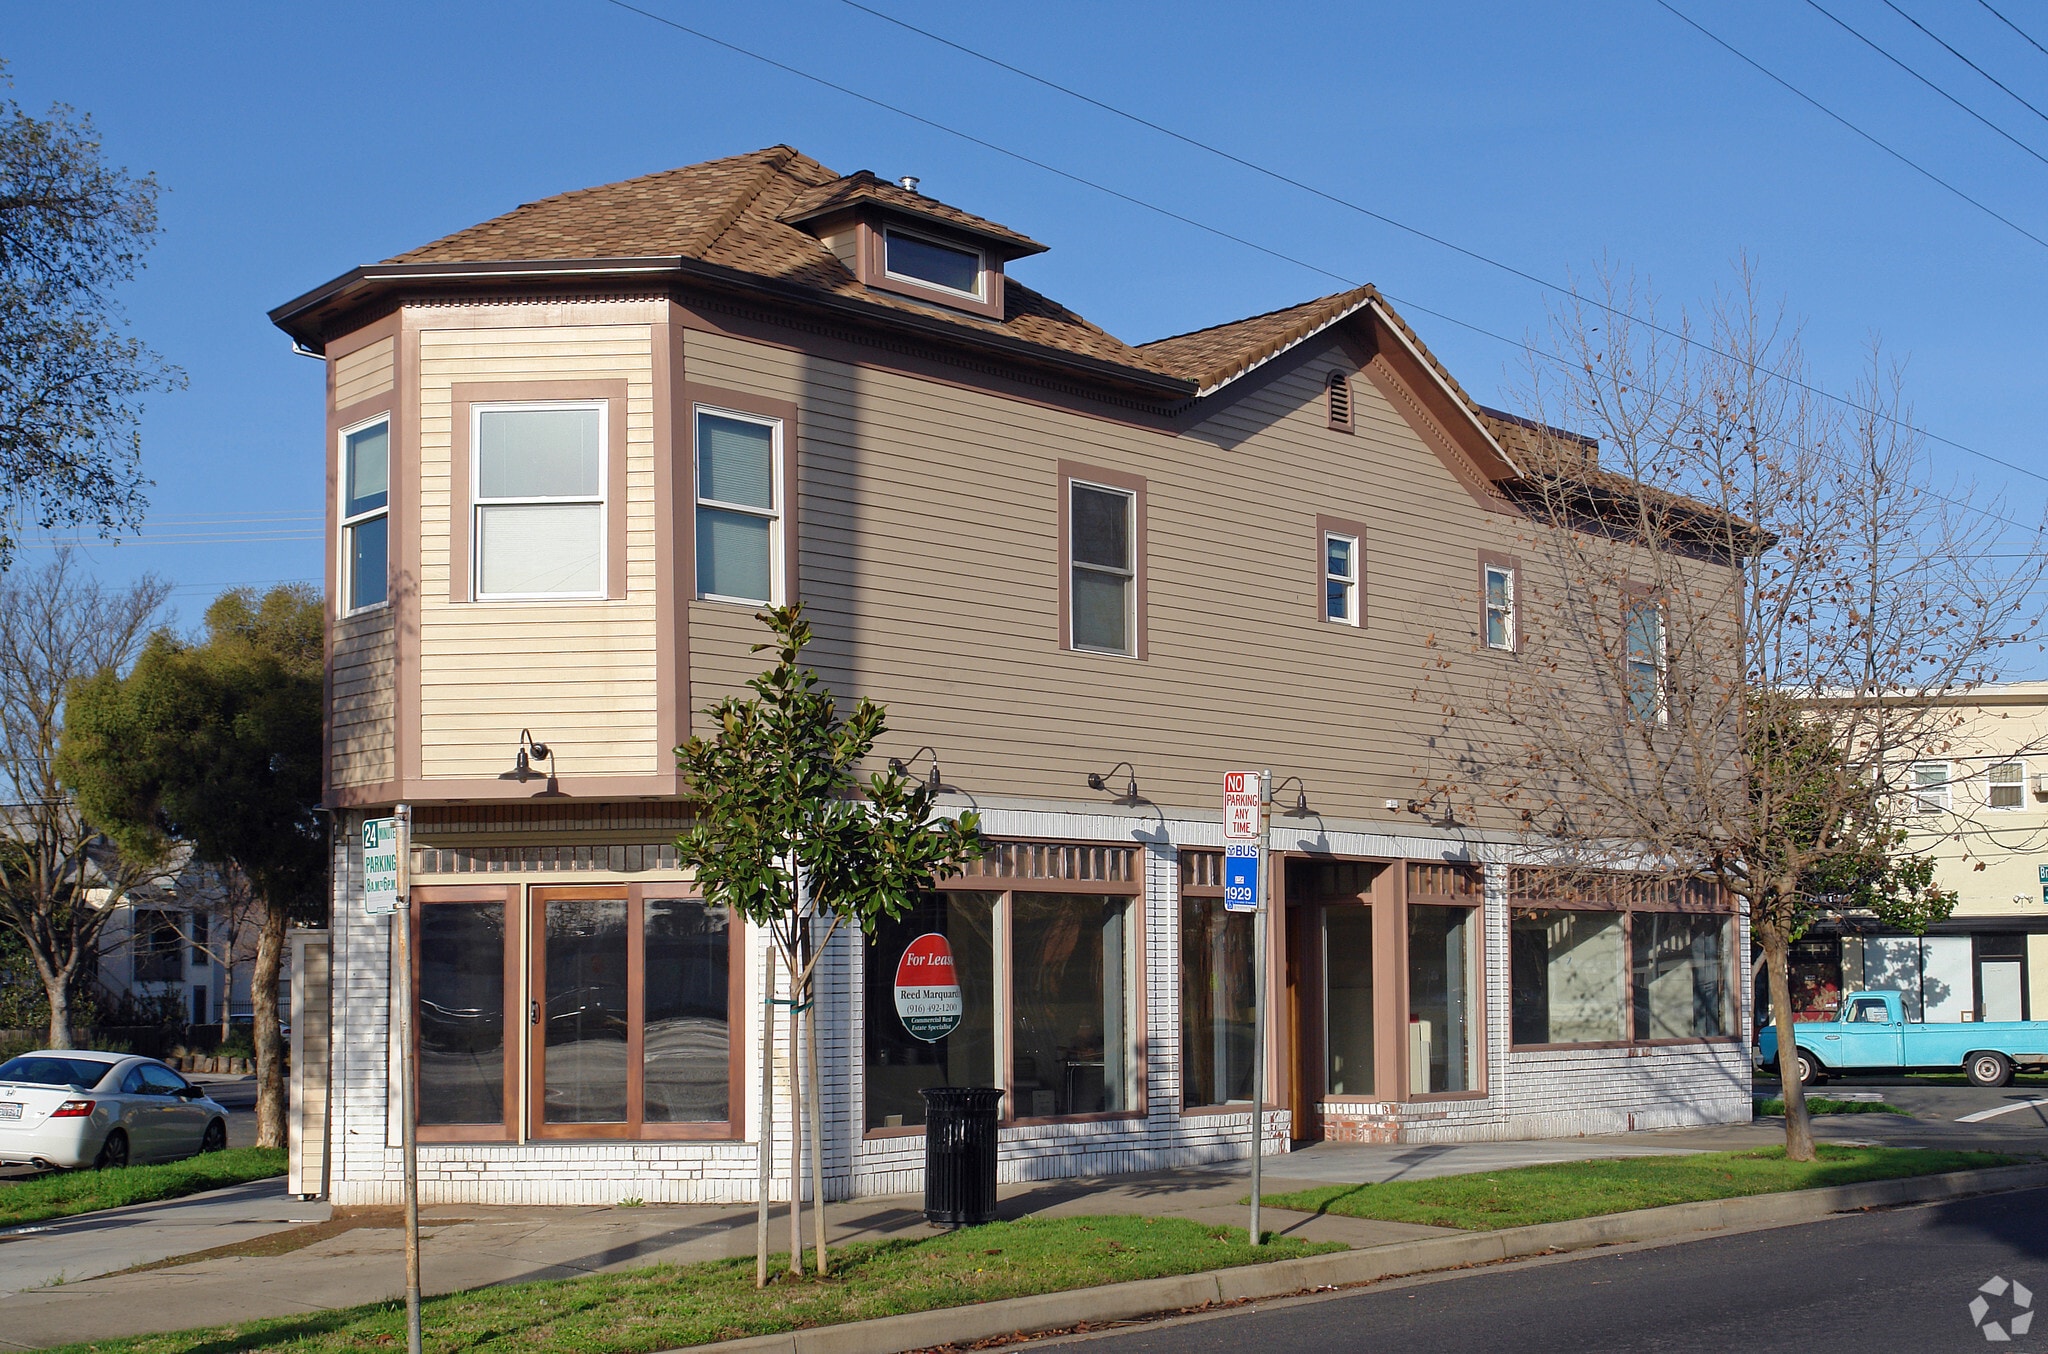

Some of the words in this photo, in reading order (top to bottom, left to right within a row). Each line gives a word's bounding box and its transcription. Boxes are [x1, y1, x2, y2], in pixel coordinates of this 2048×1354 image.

[1227, 775, 1243, 792] NO
[1226, 794, 1257, 807] PARKING
[1234, 808, 1250, 820] ANY
[1232, 821, 1251, 834] TIME
[364, 823, 377, 847] 24
[378, 826, 397, 840] MINUTE
[1235, 845, 1257, 857] BUS
[366, 854, 397, 873] PARKING
[1225, 886, 1252, 900] 1929
[906, 953, 926, 966] For
[901, 990, 921, 1000] Reed
[906, 1004, 926, 1014] (916)
[927, 1024, 952, 1032] Specialist
